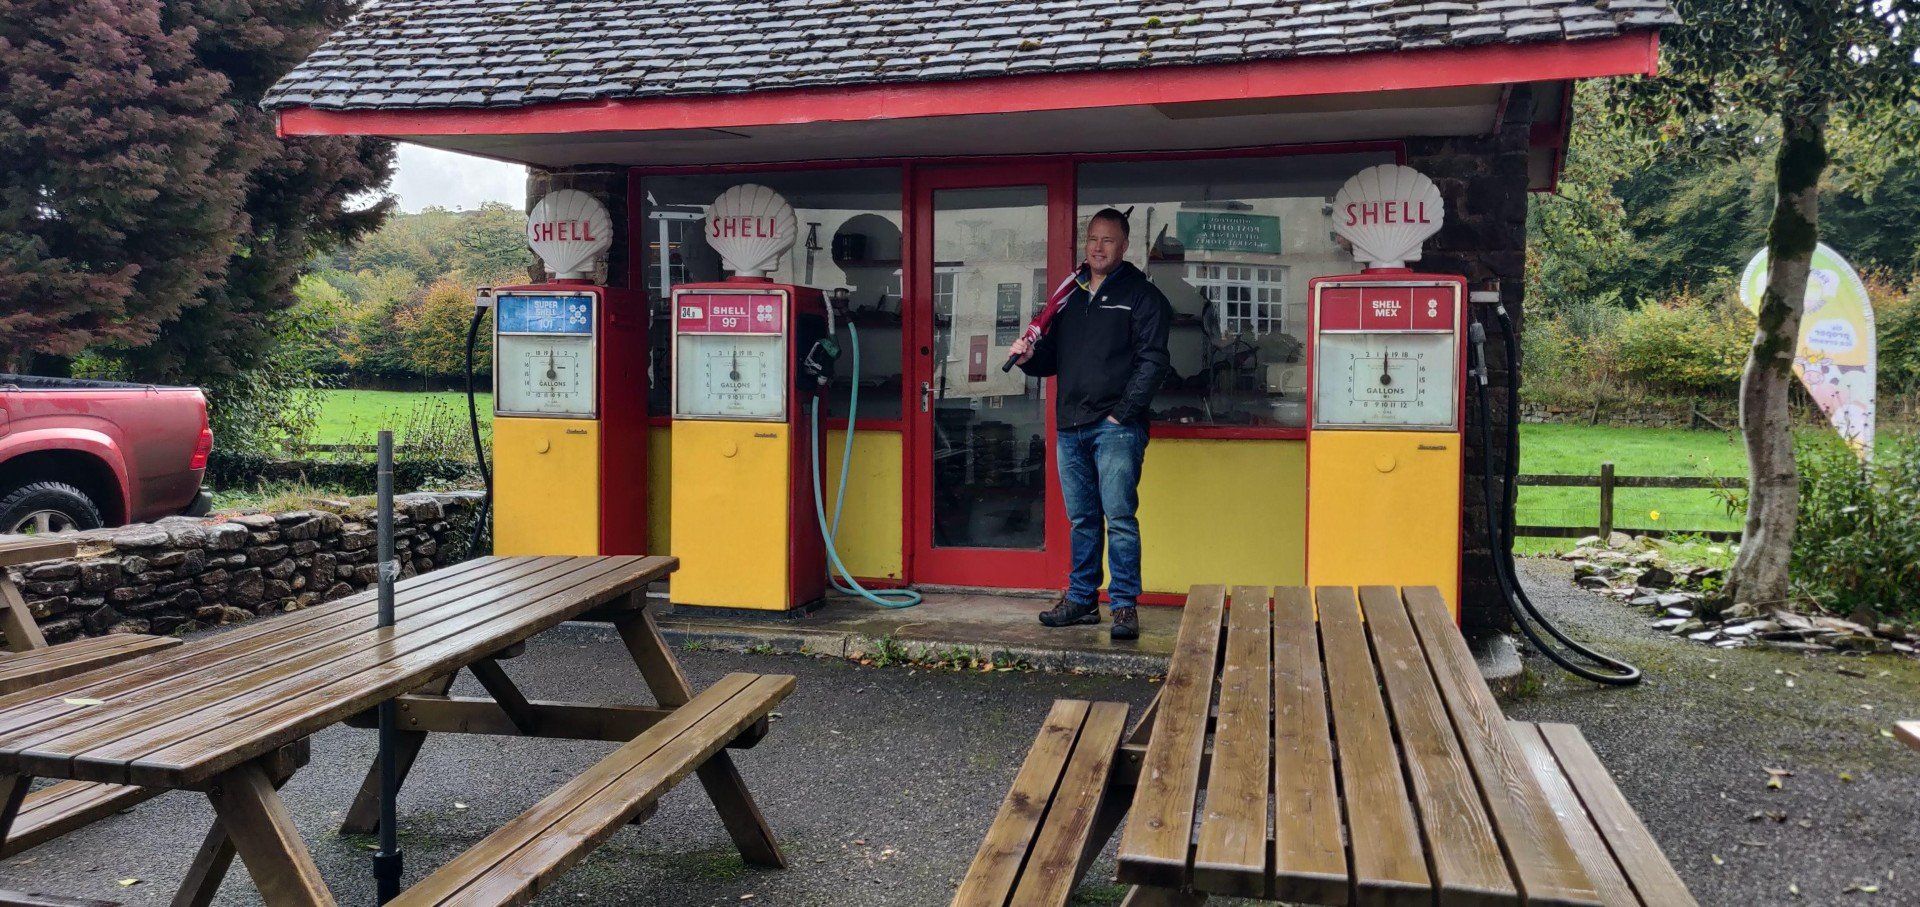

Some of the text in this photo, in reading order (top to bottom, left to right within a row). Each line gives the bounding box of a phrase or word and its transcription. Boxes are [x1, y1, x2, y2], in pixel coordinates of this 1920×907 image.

[1346, 201, 1430, 226] SHELL
[533, 221, 596, 242] SHELL
[712, 215, 780, 239] SHELL
[713, 307, 746, 315] SHELL
[1372, 301, 1401, 309] SHELL
[722, 318, 736, 327] 99
